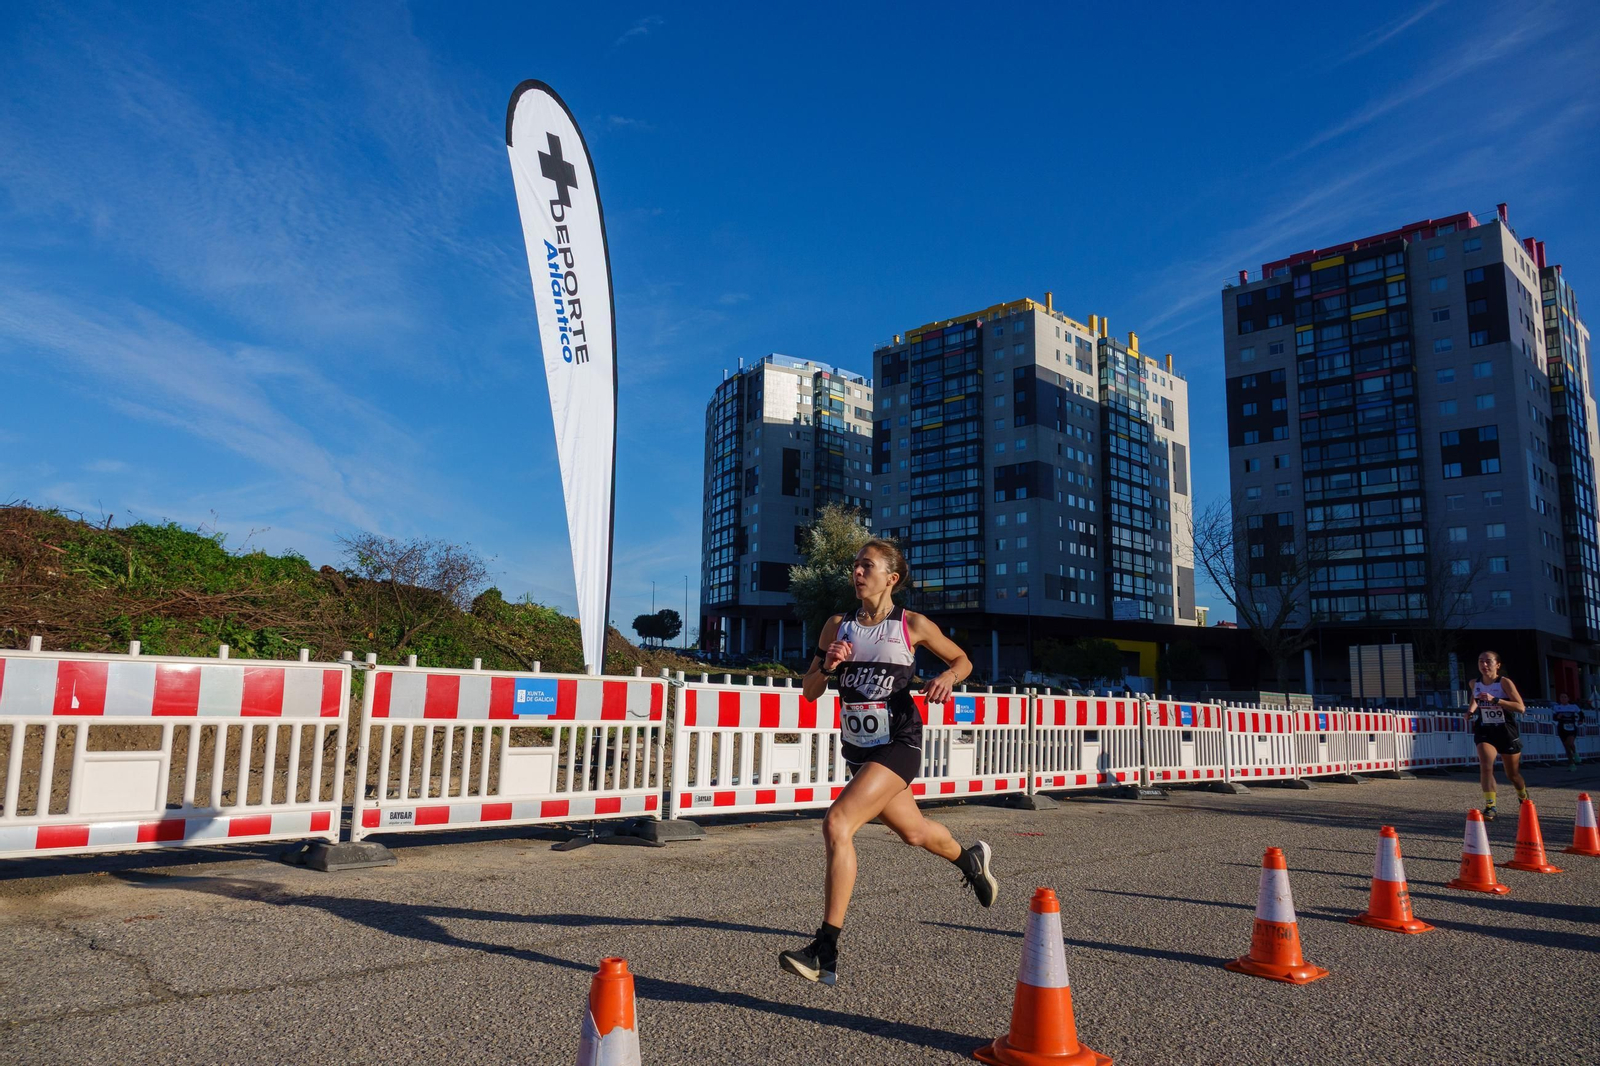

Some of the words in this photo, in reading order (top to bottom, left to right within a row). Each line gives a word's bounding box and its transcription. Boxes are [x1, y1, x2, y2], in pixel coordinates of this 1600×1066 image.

[543, 238, 573, 364] Atlántico
[549, 199, 590, 365] DEPORTE
[840, 667, 895, 690] delikia
[1485, 710, 1503, 718] 109
